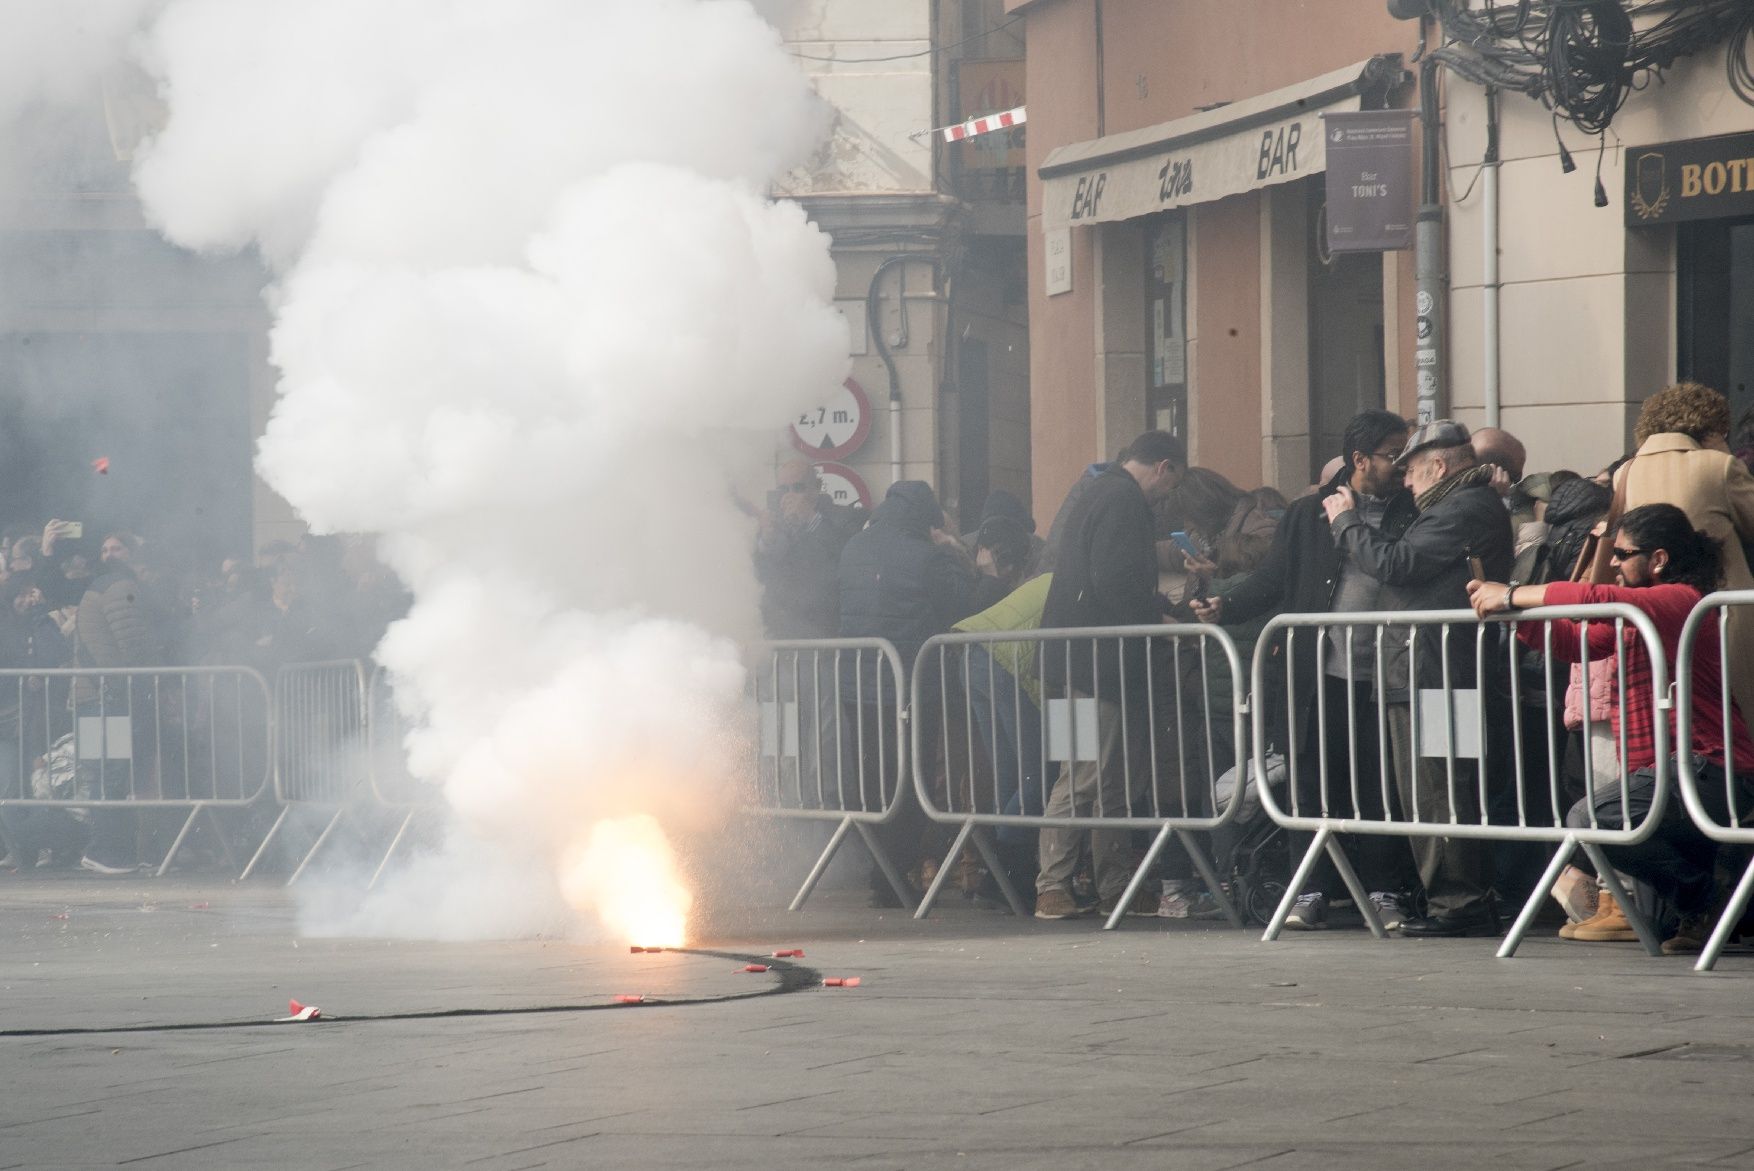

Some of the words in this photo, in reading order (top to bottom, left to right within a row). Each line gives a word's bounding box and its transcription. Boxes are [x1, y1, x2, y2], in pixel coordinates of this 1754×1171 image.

[1256, 122, 1302, 180] BAR
[1361, 171, 1377, 181] Bar
[1351, 184, 1388, 198] TONI'S
